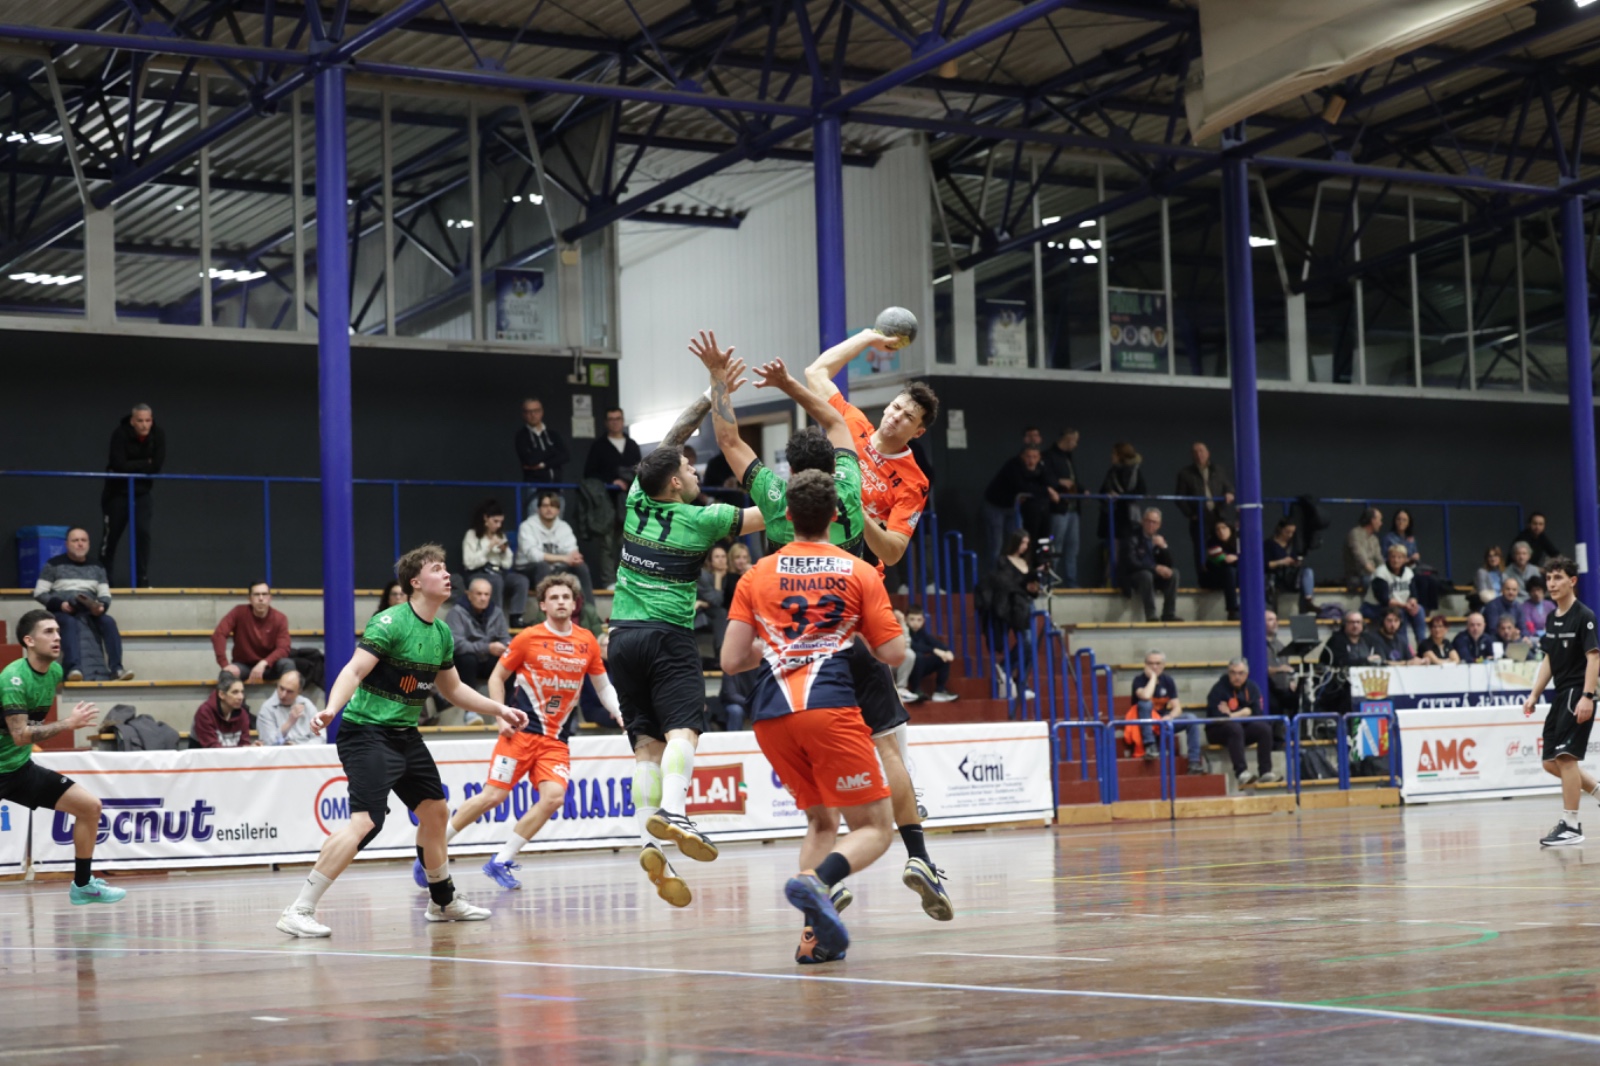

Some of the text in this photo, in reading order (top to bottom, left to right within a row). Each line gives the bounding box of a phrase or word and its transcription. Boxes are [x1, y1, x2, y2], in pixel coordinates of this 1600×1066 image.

[889, 470, 903, 488] 14
[779, 556, 836, 568] CIEFFE
[780, 565, 836, 575] MECCANICA
[779, 577, 847, 592] RINALDO
[780, 594, 847, 640] 33
[1493, 693, 1547, 707] IMOA
[1416, 737, 1477, 773] AMC
[836, 771, 872, 791] AMC
[216, 821, 278, 842] ensileria
